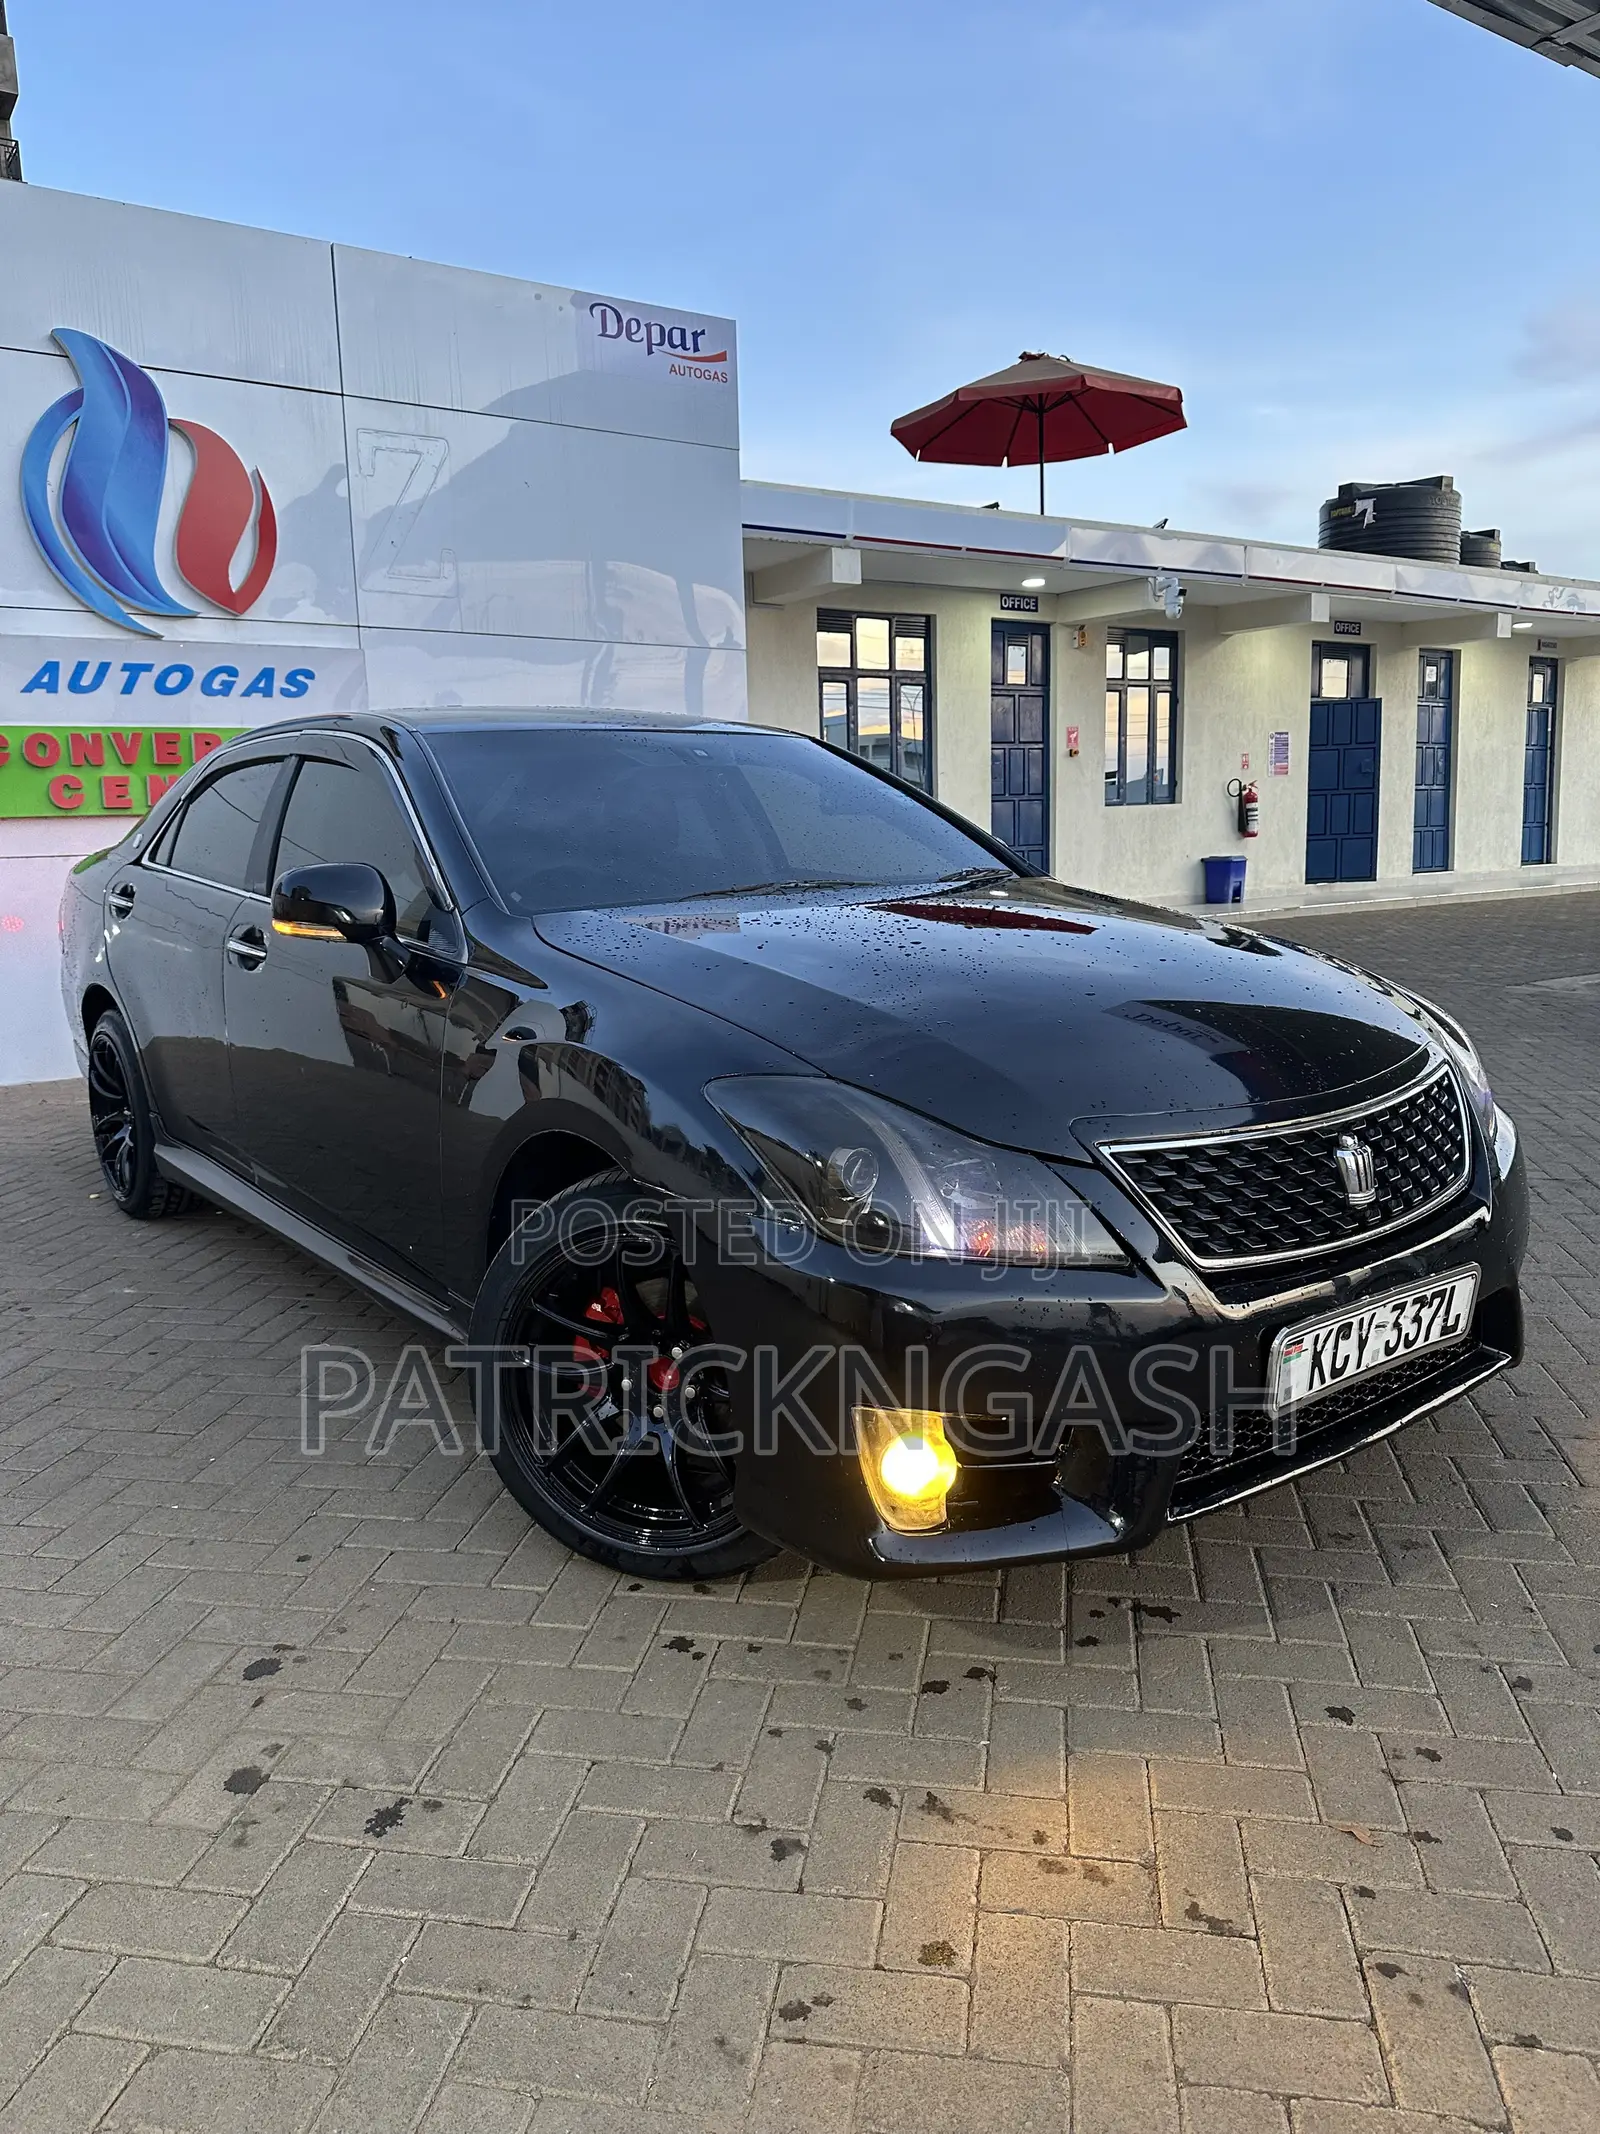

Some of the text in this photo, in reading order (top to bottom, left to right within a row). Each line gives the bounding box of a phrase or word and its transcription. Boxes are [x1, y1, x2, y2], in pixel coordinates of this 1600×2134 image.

[589, 302, 706, 356] Depar
[669, 363, 728, 384] AUTOGAS
[1001, 596, 1036, 610] OFFICE
[1335, 622, 1361, 634] OFFICE
[20, 660, 316, 699] AUTOGAS
[0, 731, 223, 768] ONVER
[1308, 1285, 1461, 1391] KCY 337L
